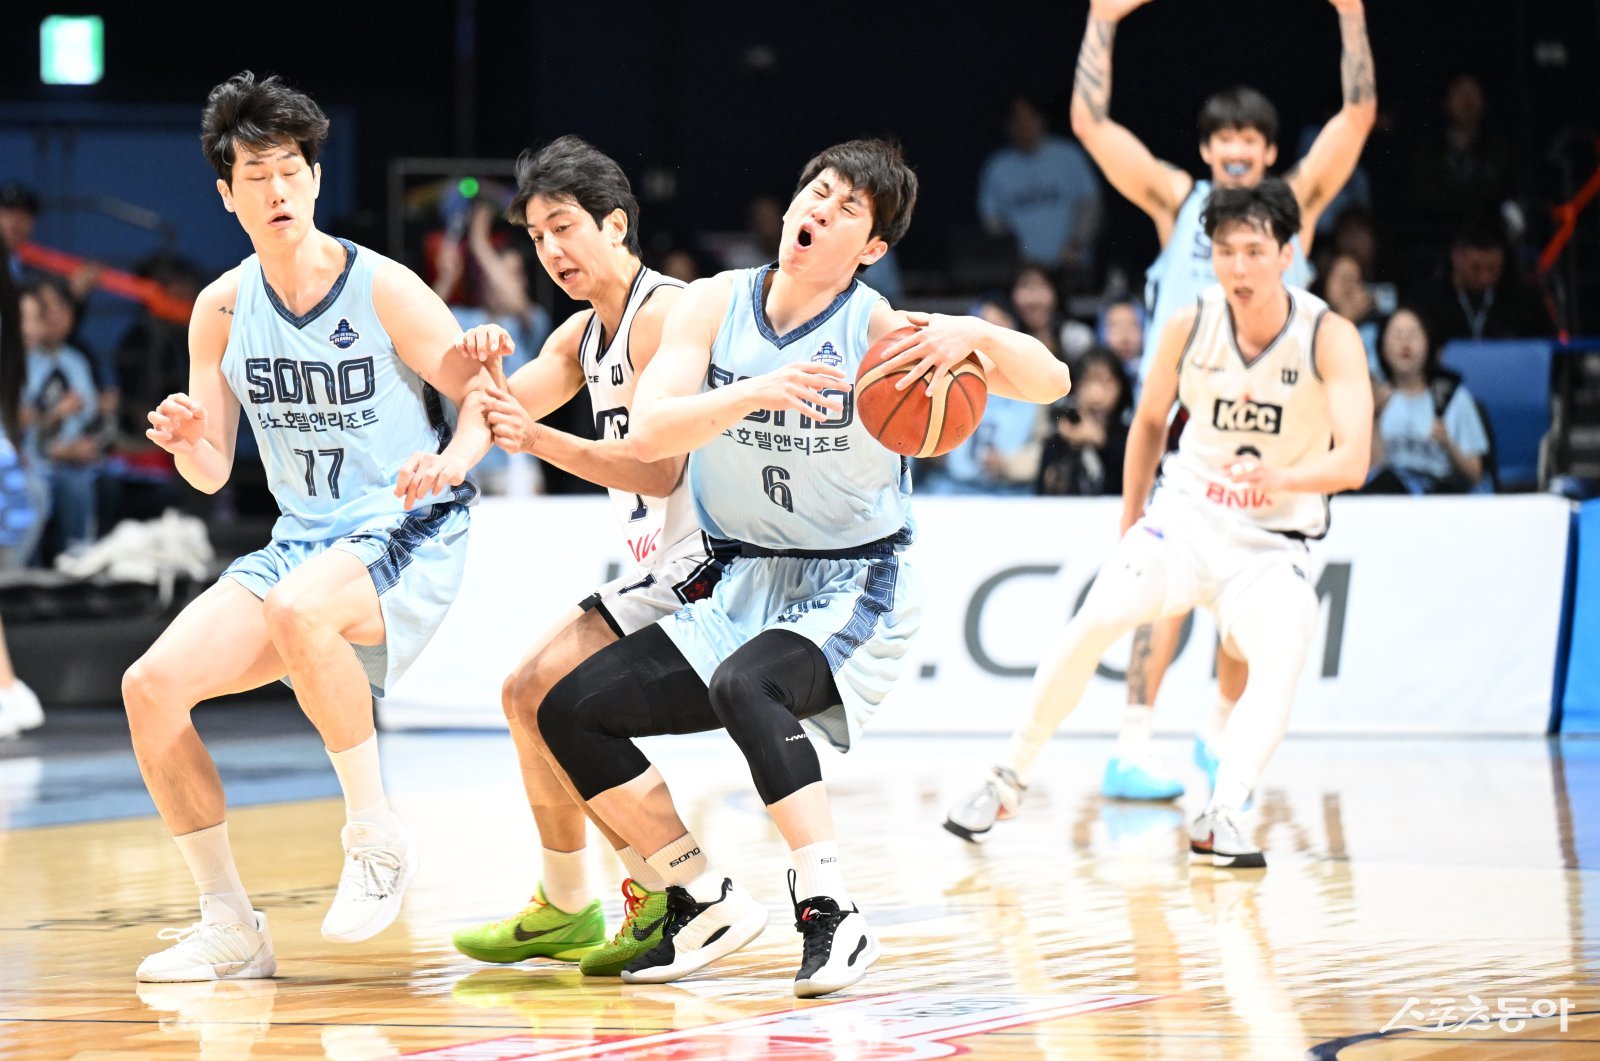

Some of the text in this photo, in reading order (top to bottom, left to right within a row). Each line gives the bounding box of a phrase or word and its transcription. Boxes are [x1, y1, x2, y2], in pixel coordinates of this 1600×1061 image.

[1215, 401, 1278, 432] KCC
[721, 426, 851, 456] 호텔앤리조트
[761, 465, 794, 513] 6
